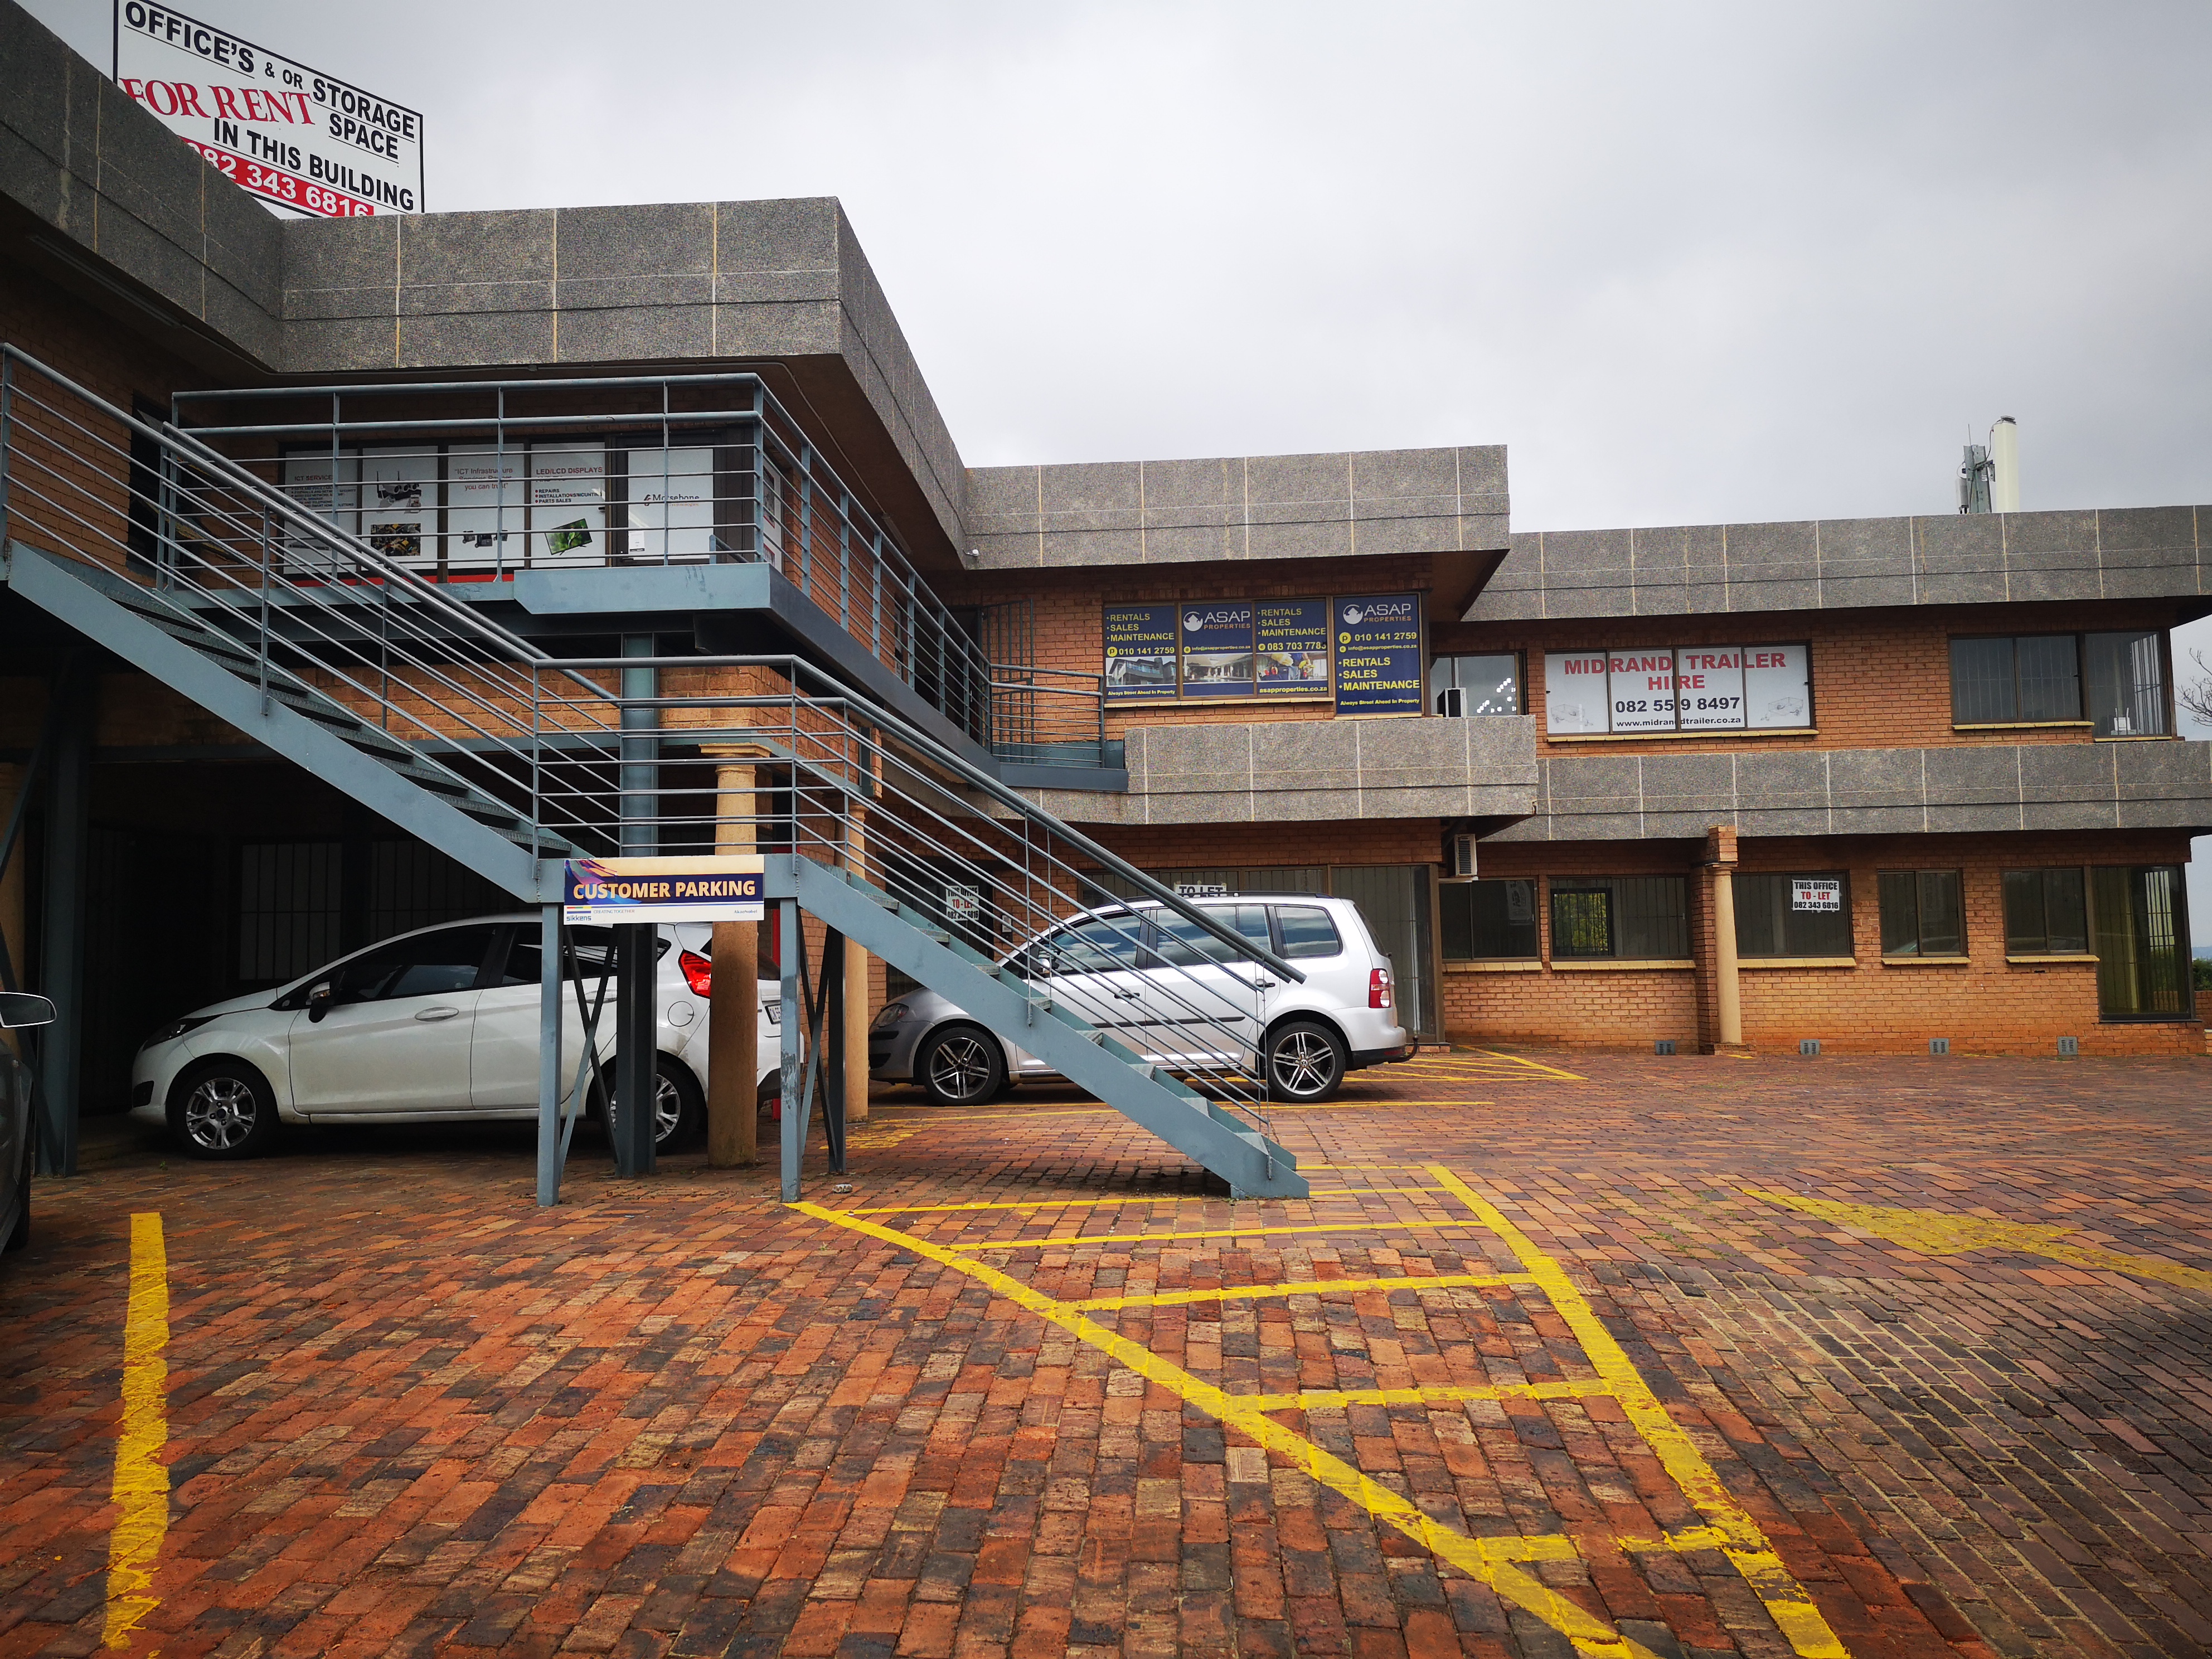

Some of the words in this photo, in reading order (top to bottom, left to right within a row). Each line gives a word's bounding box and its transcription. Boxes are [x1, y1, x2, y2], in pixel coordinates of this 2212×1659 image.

[125, 1, 254, 73] OFFICE'S
[265, 62, 274, 78] &
[283, 69, 303, 90] OR
[313, 78, 414, 139] STORAGE
[119, 77, 211, 118] FOR
[208, 85, 316, 125] RENT
[329, 113, 399, 159] SPACE
[187, 142, 236, 180] 82
[246, 164, 297, 199] 343
[215, 118, 238, 148] IN
[246, 129, 301, 171] THIS
[310, 154, 414, 211] BUILDING
[1261, 608, 1302, 617] RENTALS
[1364, 603, 1411, 616] ASAP
[1110, 613, 1150, 622] RENTALS
[1204, 610, 1250, 623] ASAP
[1110, 633, 1175, 642] MAINTENANCE
[1262, 628, 1326, 637] MAINTENANCE
[1343, 657, 1390, 667] RENTALS
[1564, 656, 1672, 675] MIDRAND
[1685, 653, 1786, 670] TRAILER
[1343, 670, 1377, 678] SALES
[1343, 680, 1420, 691] MAINTENANCE
[1648, 675, 1705, 691] HIRE
[1616, 700, 1647, 713] 082
[1653, 698, 1691, 711] 559
[1697, 697, 1740, 710] 8497
[1616, 717, 1741, 727] www.midrandtrailer.co.za
[574, 882, 671, 899] CUSTOMER
[675, 880, 755, 897] PARKING
[1179, 886, 1195, 898] TO
[1200, 886, 1223, 897] LET
[1801, 891, 1811, 900] TO
[952, 899, 959, 909] TO
